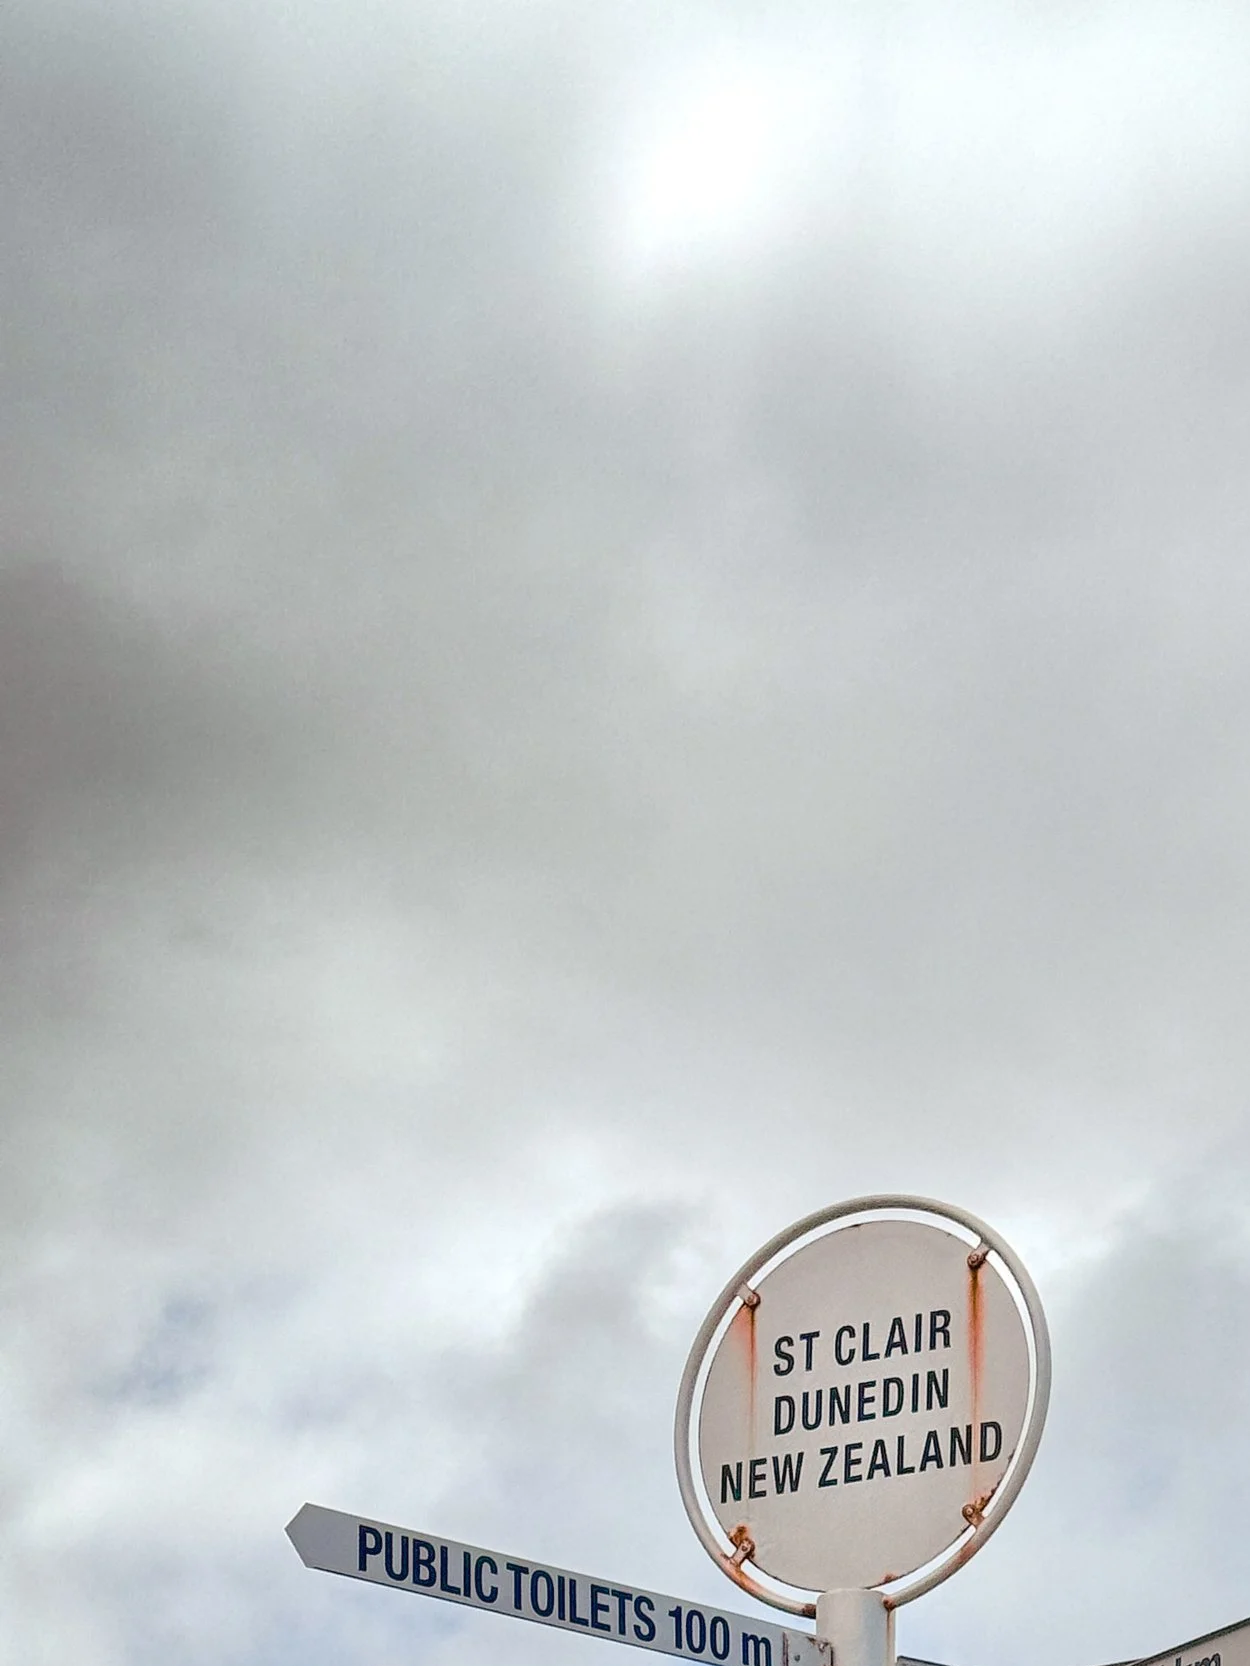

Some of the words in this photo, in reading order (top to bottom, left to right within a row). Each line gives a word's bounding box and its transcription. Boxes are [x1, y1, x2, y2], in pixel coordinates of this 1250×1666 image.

[773, 1330, 820, 1377] ST
[835, 1309, 951, 1366] CLAIR
[774, 1368, 949, 1436] DUNEDIN
[720, 1451, 805, 1504] NEW
[818, 1421, 1002, 1488] ZEALAND
[358, 1525, 499, 1603] PUBLIC
[506, 1563, 656, 1642] TOILETS
[668, 1606, 730, 1660] 100
